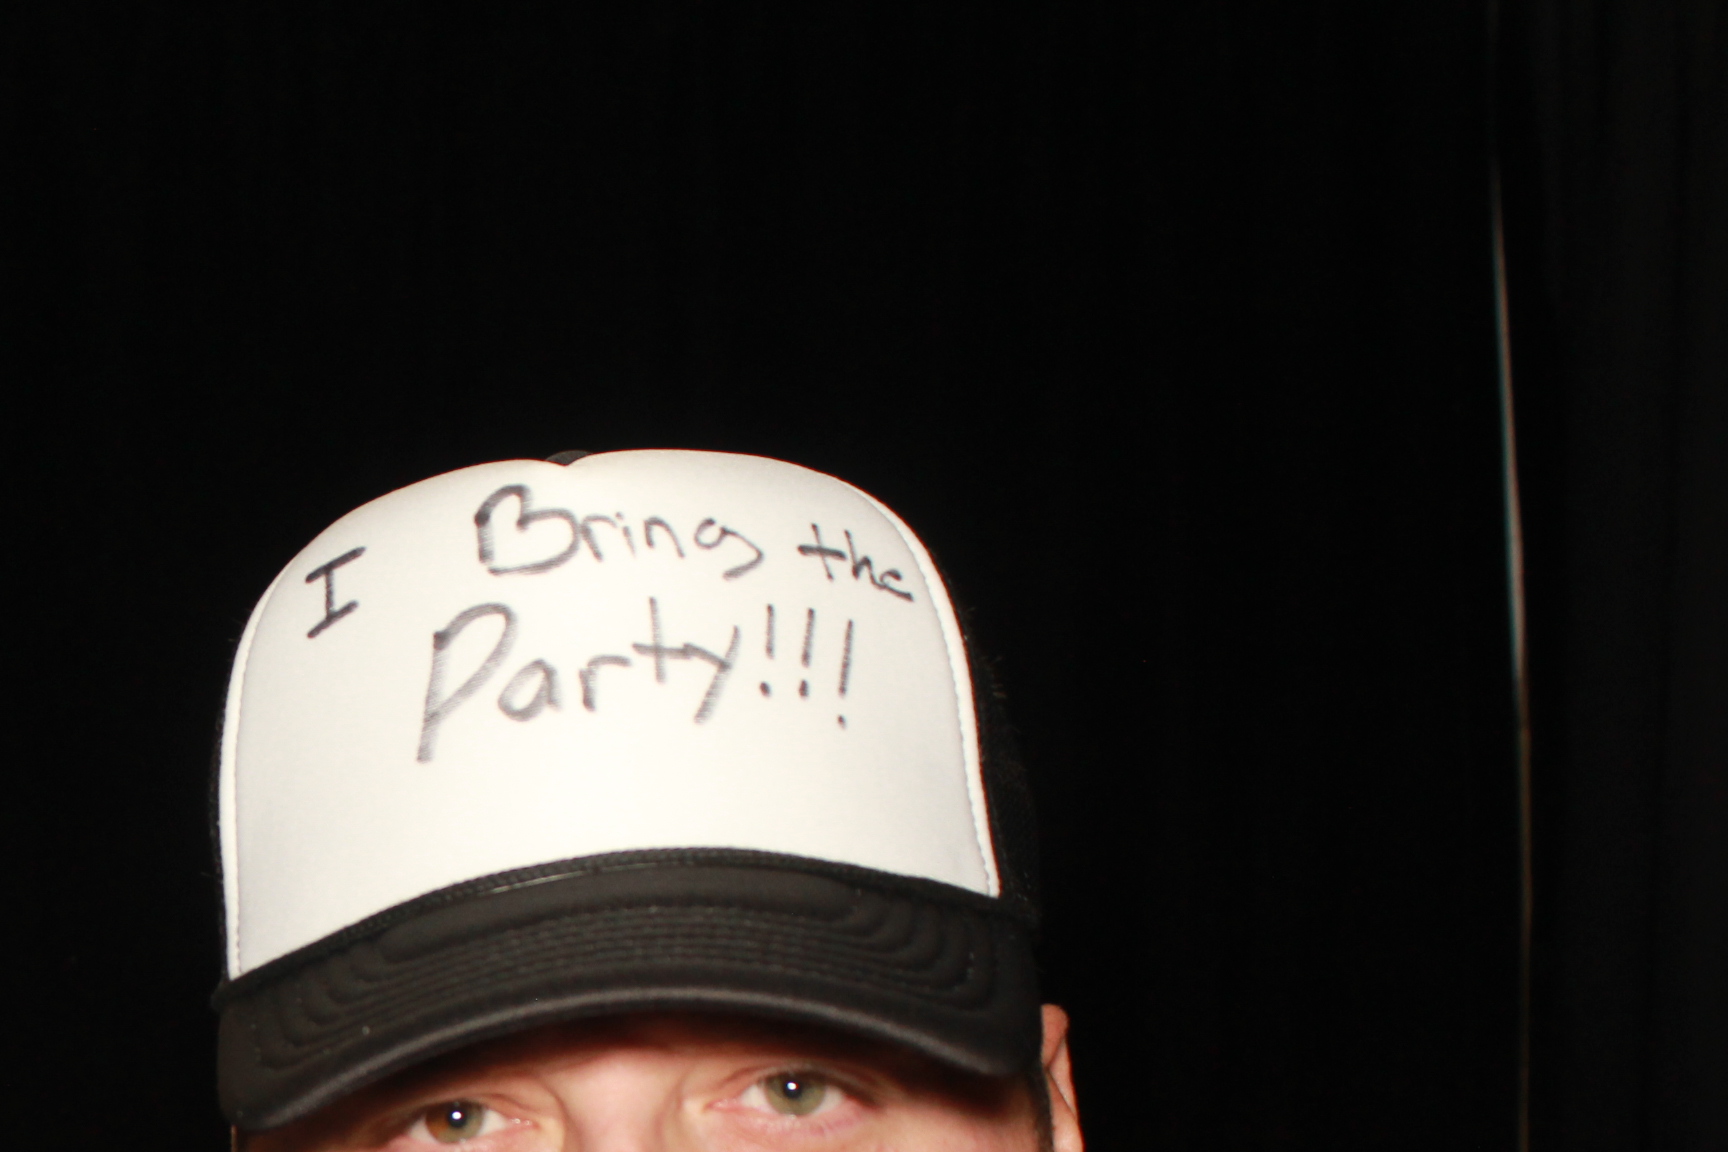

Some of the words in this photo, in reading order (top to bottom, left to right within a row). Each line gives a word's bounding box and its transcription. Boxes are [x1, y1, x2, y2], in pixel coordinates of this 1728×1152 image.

[305, 546, 366, 638] I
[474, 484, 765, 580] Bring
[798, 523, 914, 602] the
[416, 597, 855, 763] Party!!!
